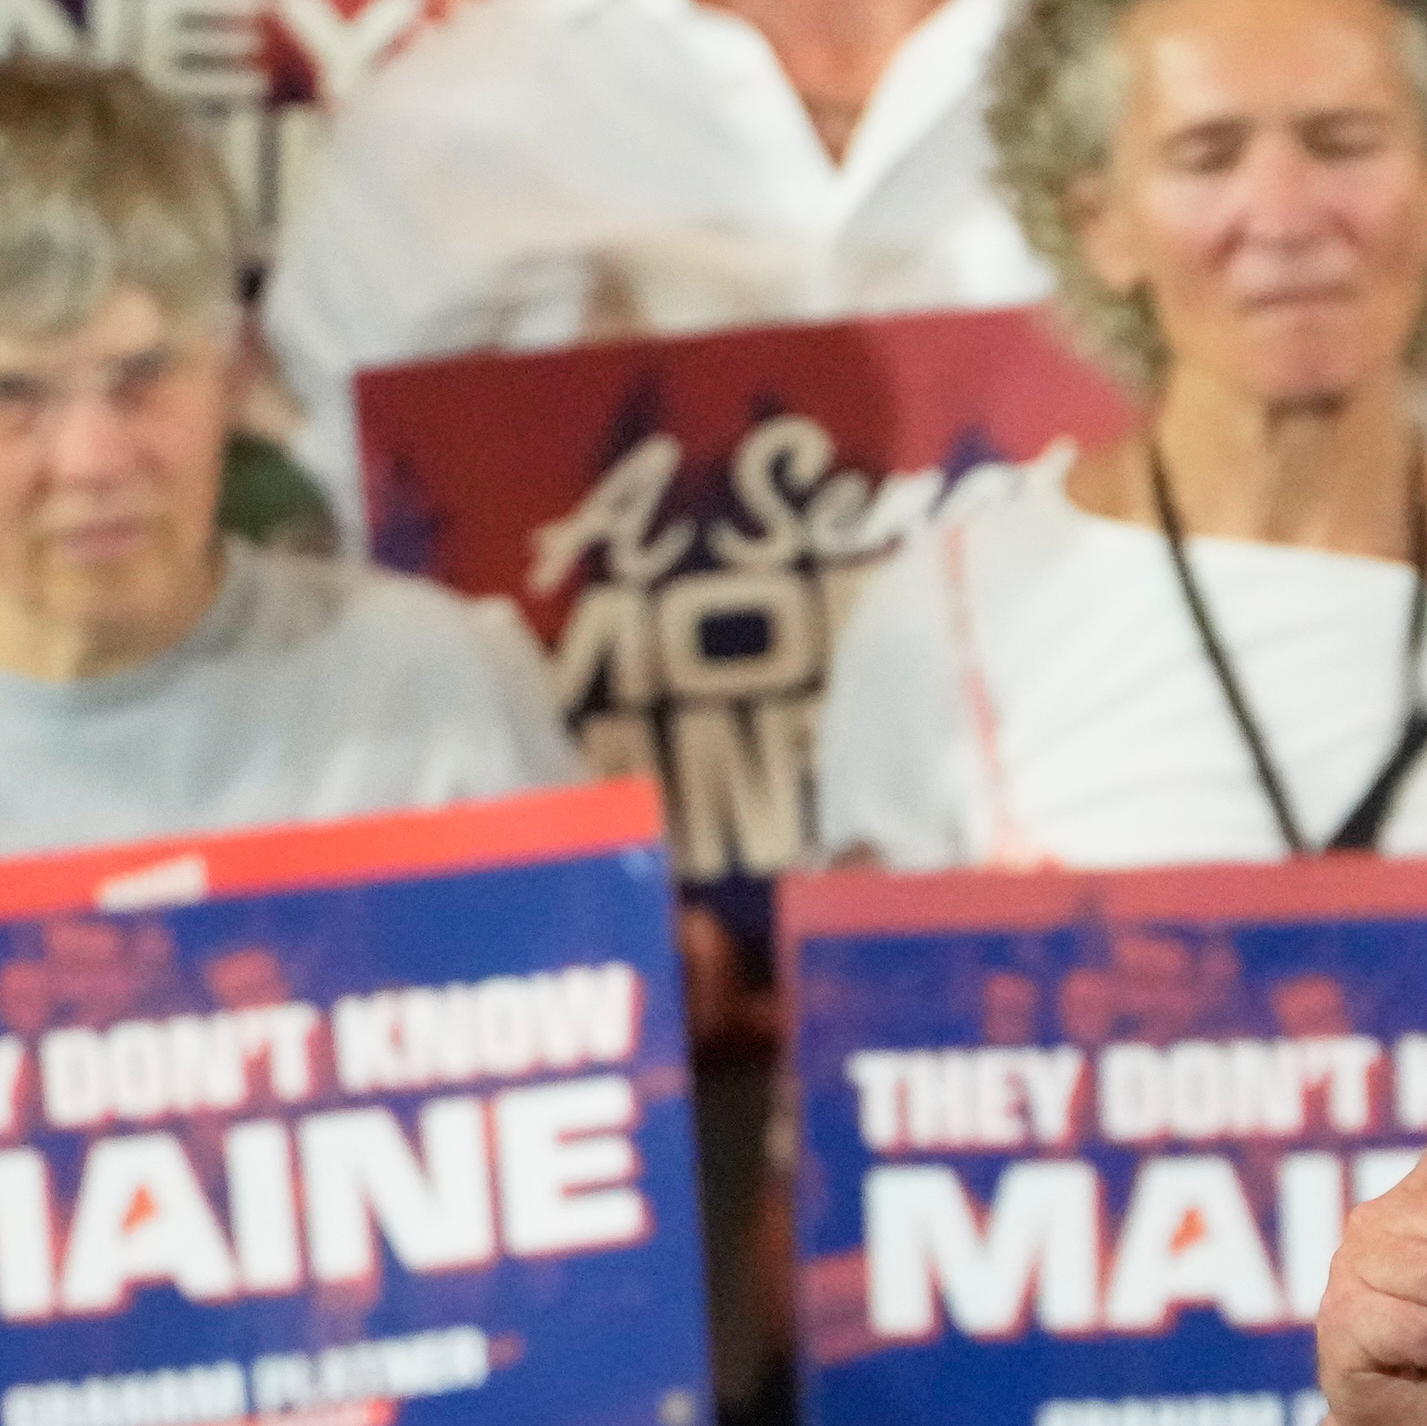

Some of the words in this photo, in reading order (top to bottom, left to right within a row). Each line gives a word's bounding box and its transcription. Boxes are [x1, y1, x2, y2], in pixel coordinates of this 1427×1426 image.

[525, 430, 697, 597] A
[40, 1000, 314, 1128] DON'T
[334, 962, 638, 1091] KNOW
[847, 1046, 1084, 1148] THEY
[1098, 1034, 1382, 1140] DON'T
